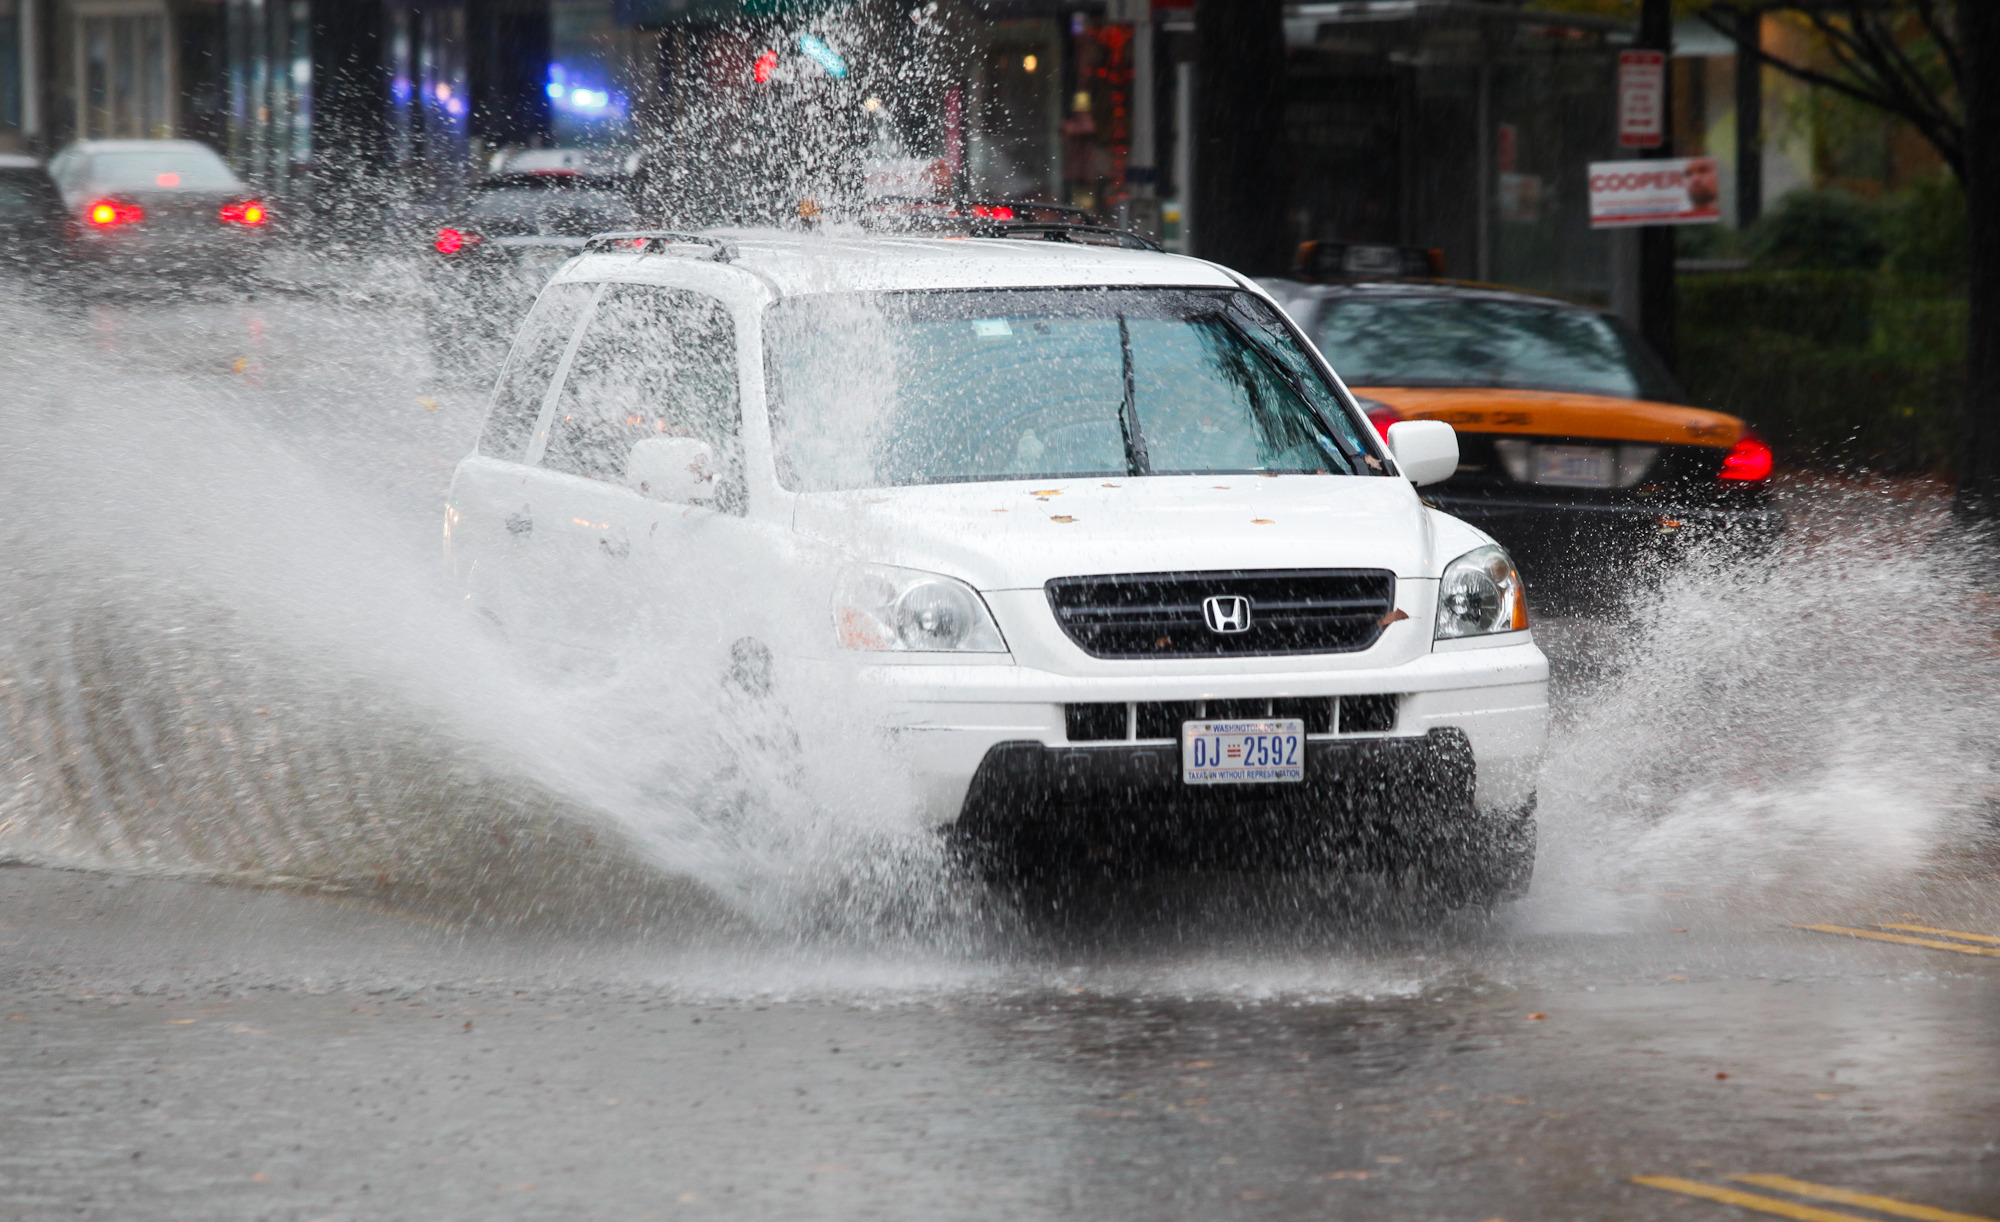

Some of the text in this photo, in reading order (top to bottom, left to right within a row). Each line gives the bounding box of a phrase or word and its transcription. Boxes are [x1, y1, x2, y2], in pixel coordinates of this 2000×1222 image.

[1590, 171, 1684, 191] COOPER
[1264, 723, 1274, 732] DC
[1194, 735, 1298, 767] DJ 2592
[1188, 771, 1216, 780] TAXATN
[1218, 770, 1245, 779] WITHOUT
